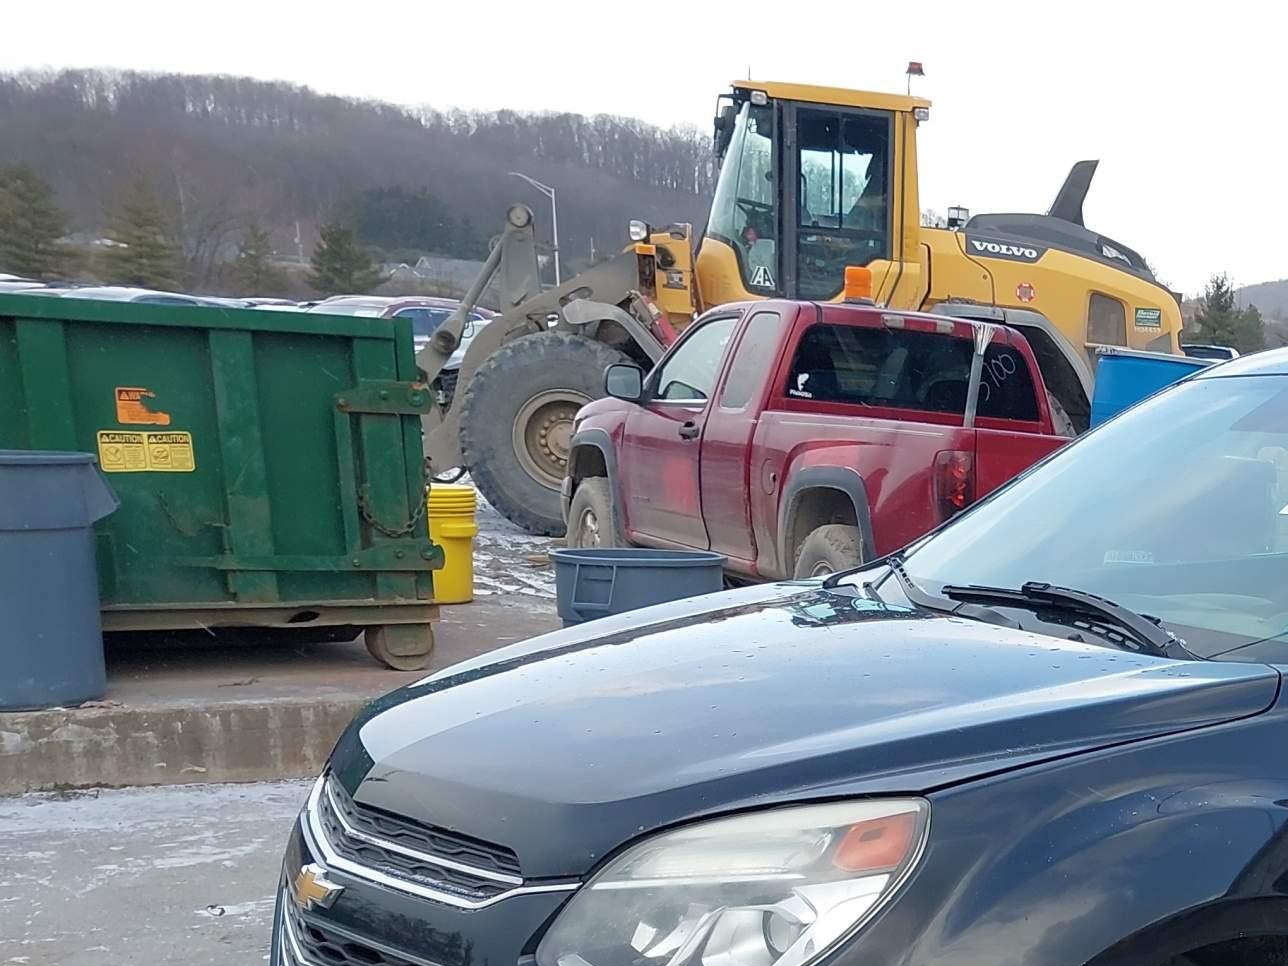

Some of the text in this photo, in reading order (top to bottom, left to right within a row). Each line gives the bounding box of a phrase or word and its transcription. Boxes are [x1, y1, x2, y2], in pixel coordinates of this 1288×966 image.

[971, 240, 1038, 259] VOLVO
[108, 434, 145, 443] CAUTION
[155, 435, 190, 443] CAUTION
